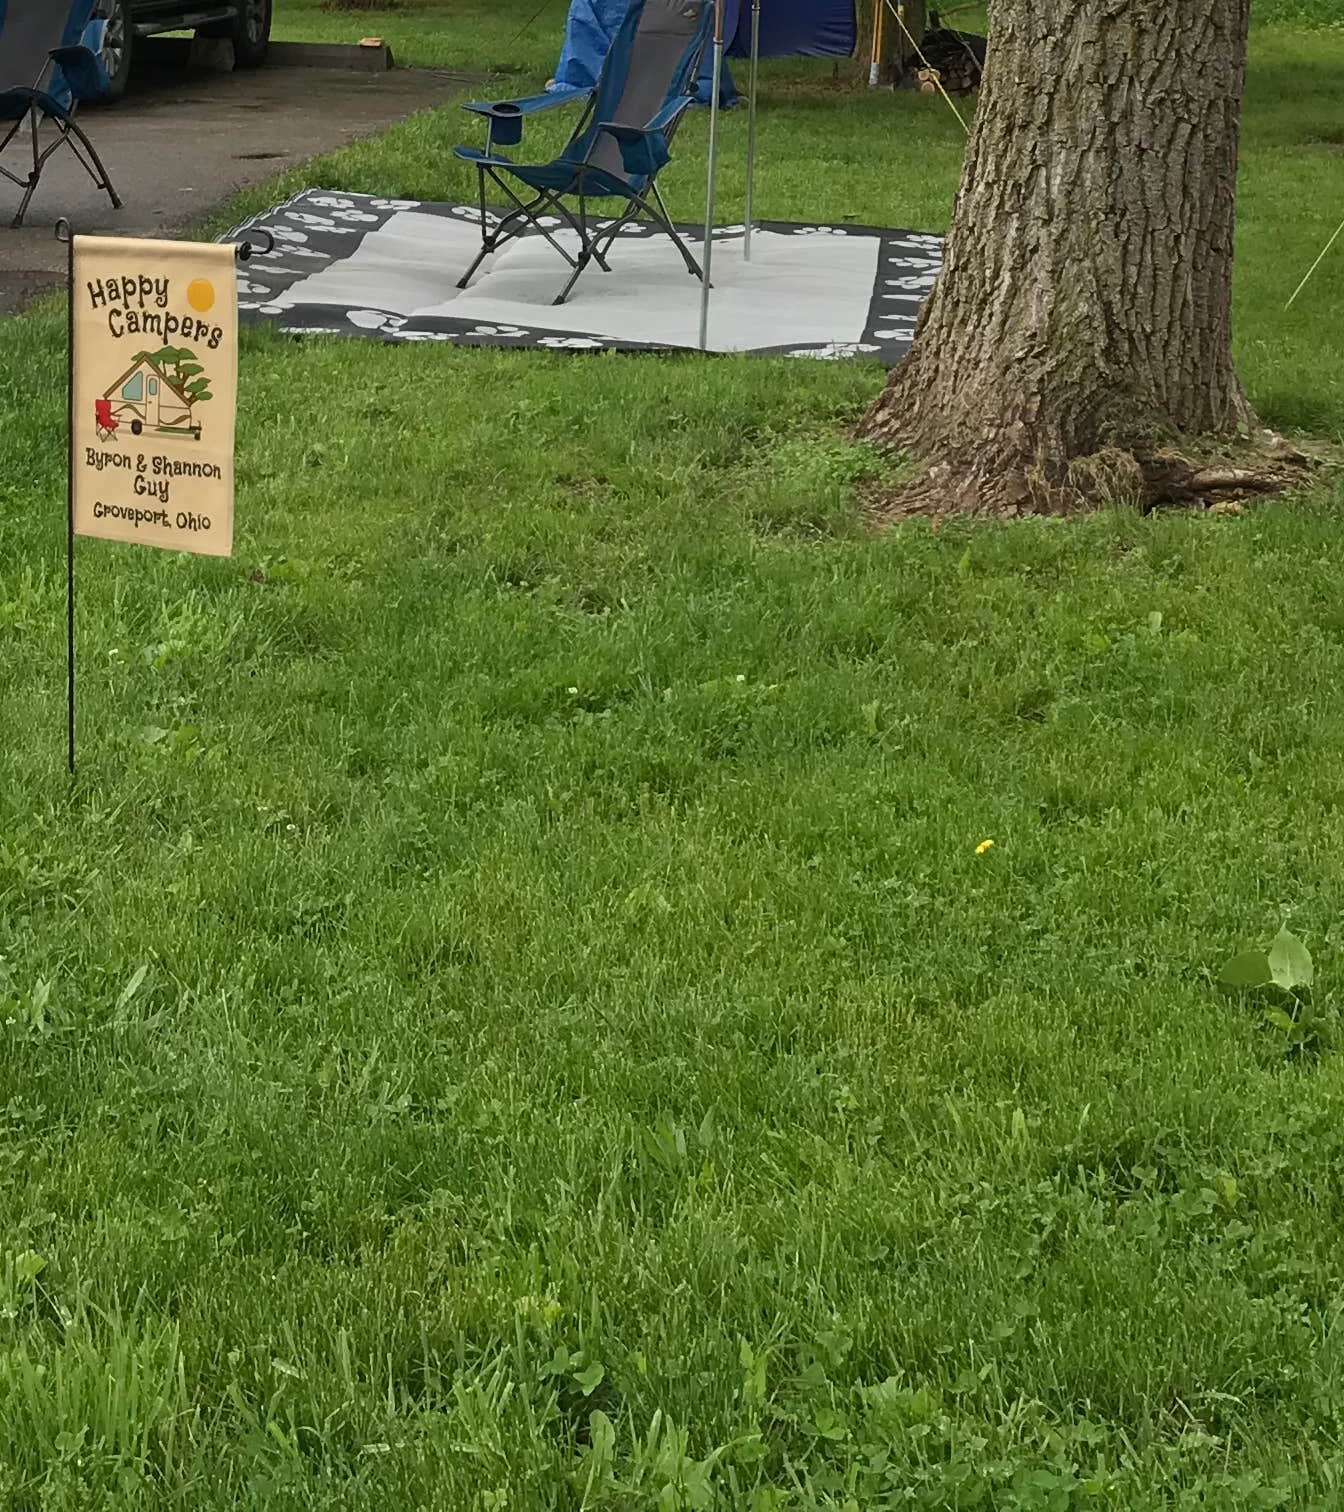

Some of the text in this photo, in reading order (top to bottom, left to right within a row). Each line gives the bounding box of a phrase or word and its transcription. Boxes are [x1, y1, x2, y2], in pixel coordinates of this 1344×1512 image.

[87, 274, 169, 309] Happy
[108, 308, 223, 349] Campers
[86, 447, 221, 480] Byron & Shannon
[134, 475, 169, 503] Guy
[93, 501, 211, 532] Groveport, Ohio
